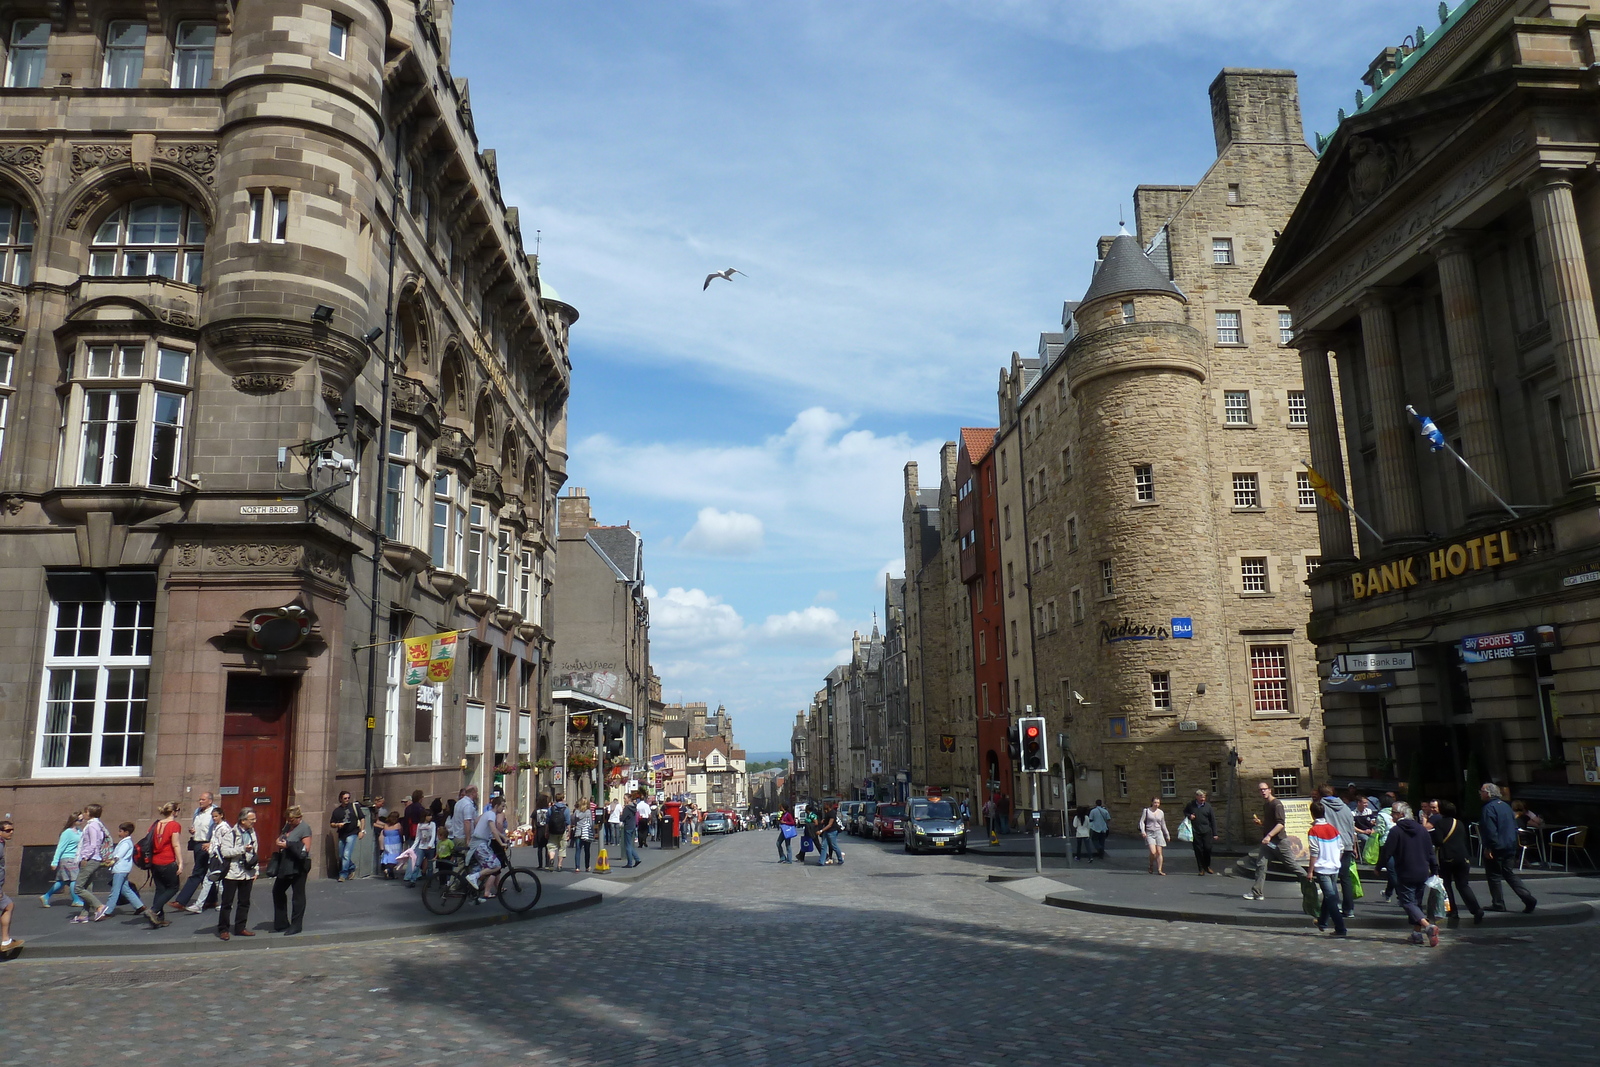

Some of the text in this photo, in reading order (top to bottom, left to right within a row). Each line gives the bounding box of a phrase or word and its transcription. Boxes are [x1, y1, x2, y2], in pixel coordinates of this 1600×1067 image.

[1351, 530, 1518, 599] BANK HOTEL
[1568, 565, 1587, 575] ROYAL
[1589, 562, 1600, 571] MIL
[1565, 573, 1599, 585] HIGH STREET
[1099, 617, 1169, 645] Radisson
[1465, 633, 1525, 649] sky SPORTS 3D
[1476, 650, 1494, 660] LIVE
[1494, 648, 1515, 658] HERE
[1352, 657, 1406, 667] The Bank Bar
